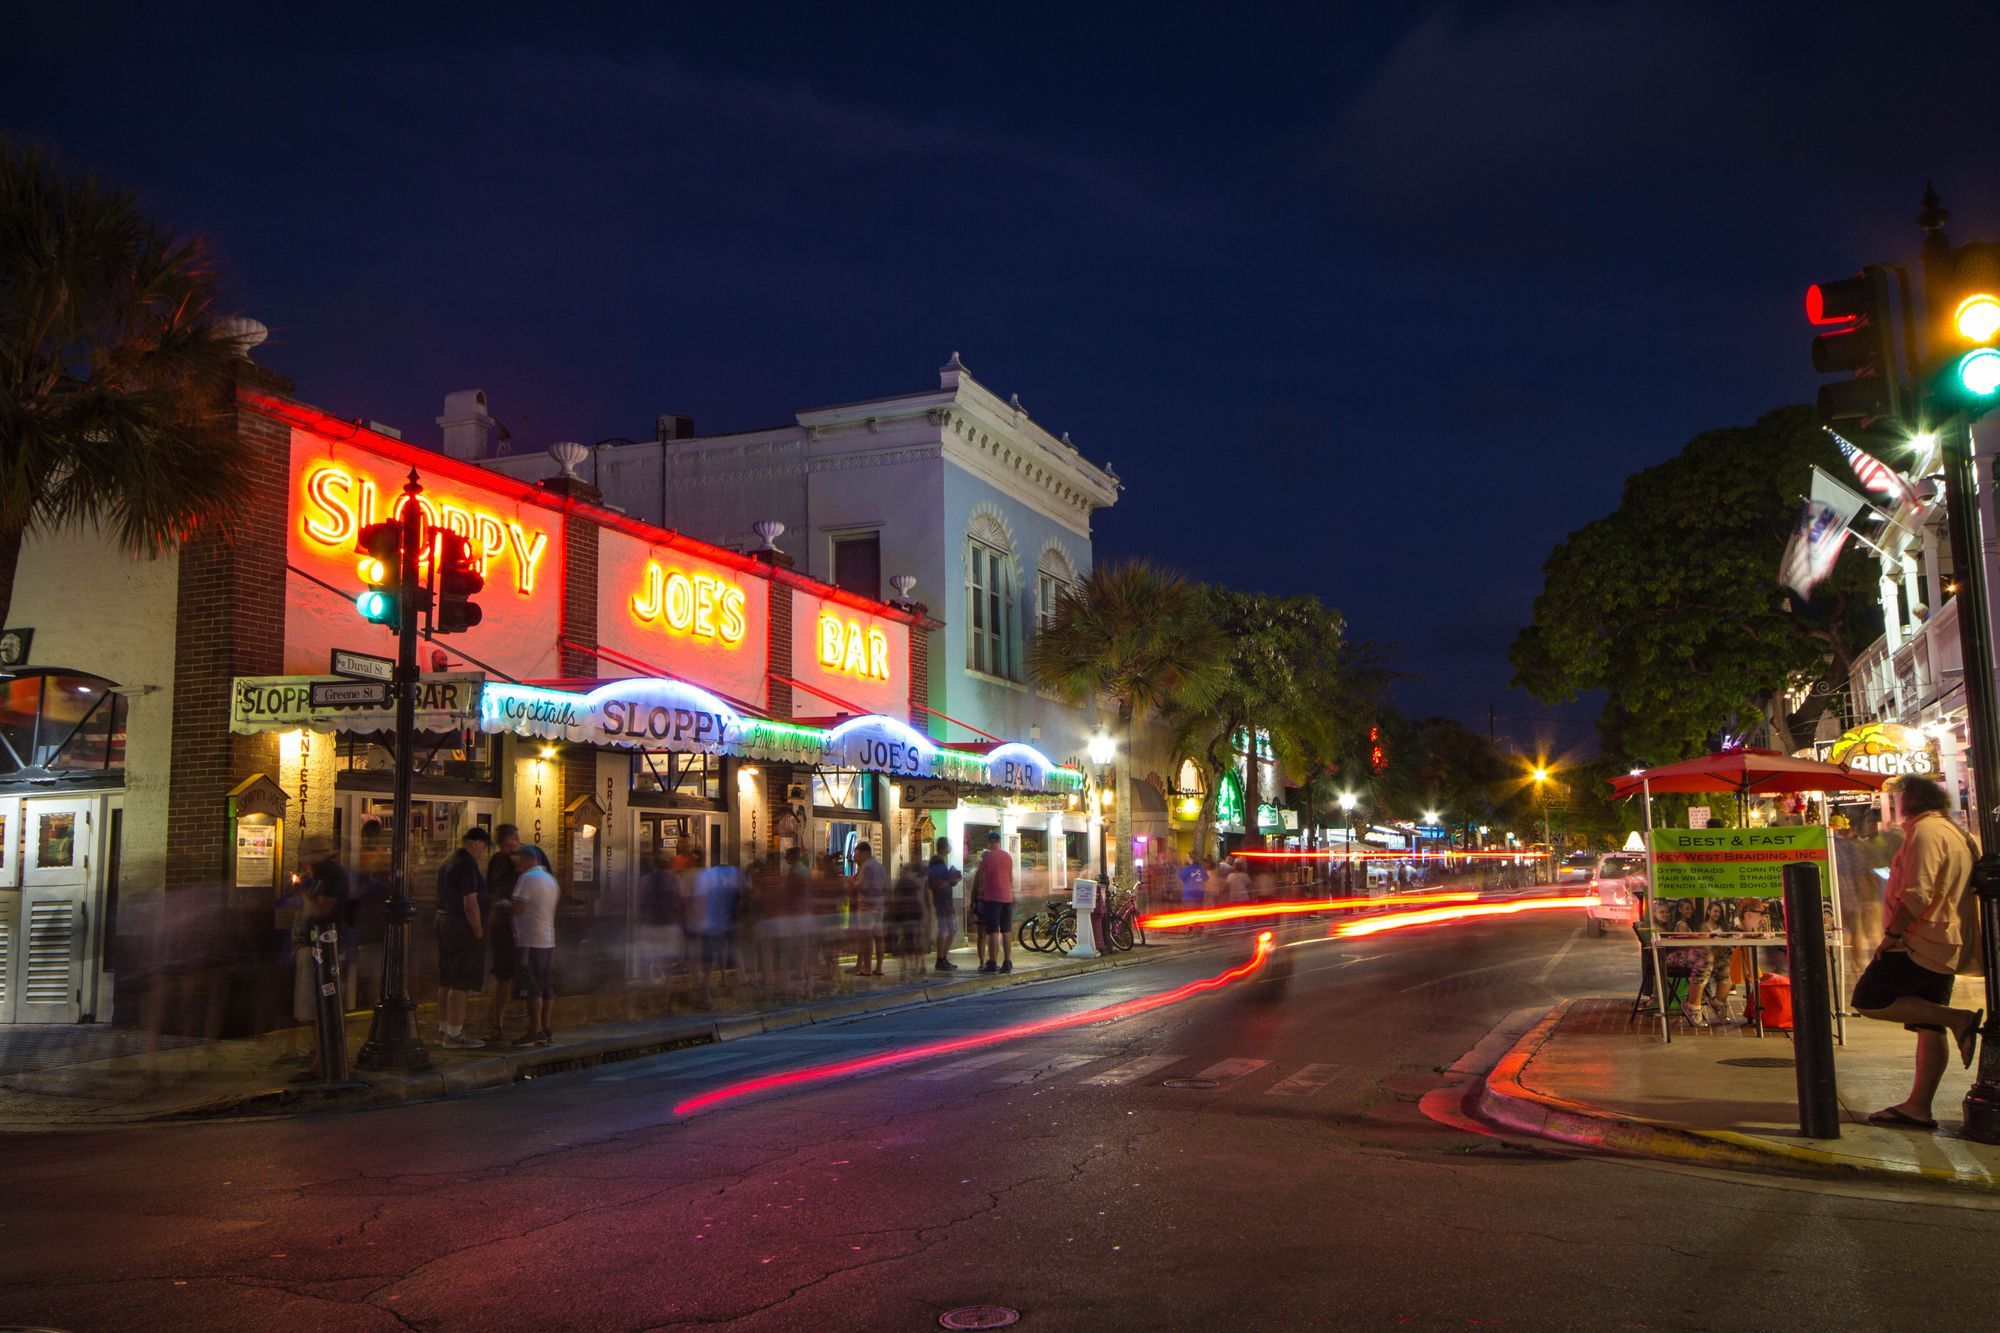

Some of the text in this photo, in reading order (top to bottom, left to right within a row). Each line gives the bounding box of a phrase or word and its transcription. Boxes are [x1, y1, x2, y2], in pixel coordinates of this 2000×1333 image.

[631, 564, 746, 643] JOE'S
[819, 614, 890, 680] BAR
[347, 658, 373, 674] Duval
[374, 663, 383, 676] St
[241, 686, 316, 715] SLOPP
[324, 687, 373, 700] Greene St
[505, 696, 578, 727] Cocktails
[602, 700, 733, 746] SLOPPY
[859, 739, 919, 772] JOE'S
[1004, 761, 1034, 787] BAR
[1678, 835, 1795, 846] BEST & FAST
[1656, 851, 1822, 862] KEY WEST BRAIDING, INC.
